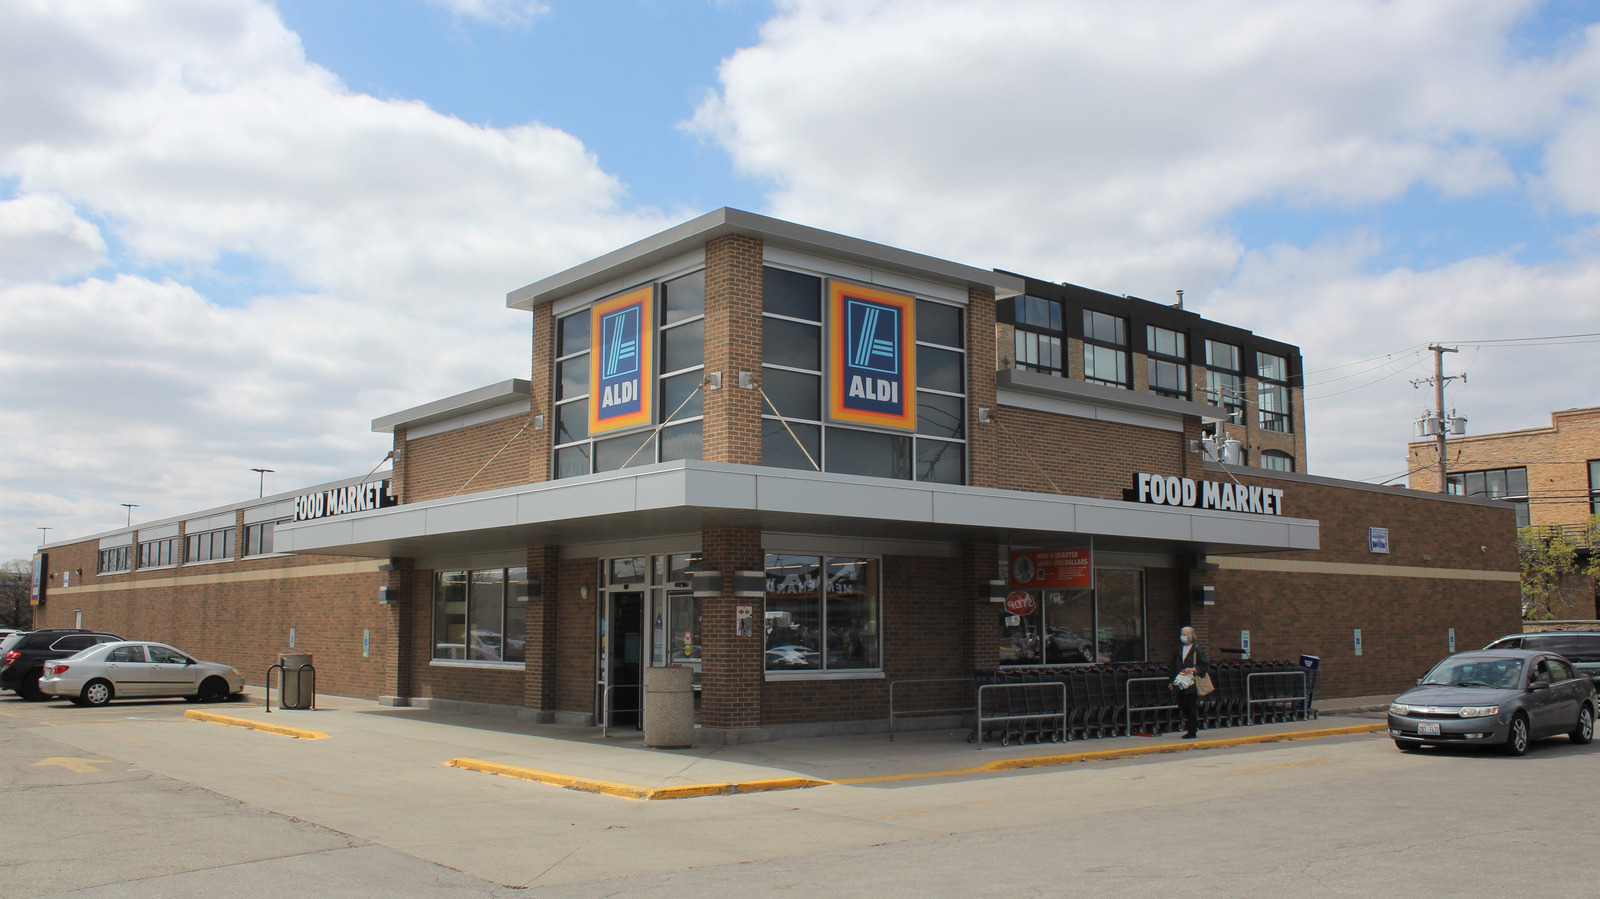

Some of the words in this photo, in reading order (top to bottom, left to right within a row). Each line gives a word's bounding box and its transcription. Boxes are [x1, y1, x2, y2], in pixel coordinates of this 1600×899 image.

[602, 379, 638, 408] ALDI
[849, 375, 898, 403] ALDI
[293, 492, 325, 521] FOOD
[326, 480, 383, 516] MARKET
[1138, 472, 1197, 506] FOOD
[1202, 480, 1284, 515] MARKET
